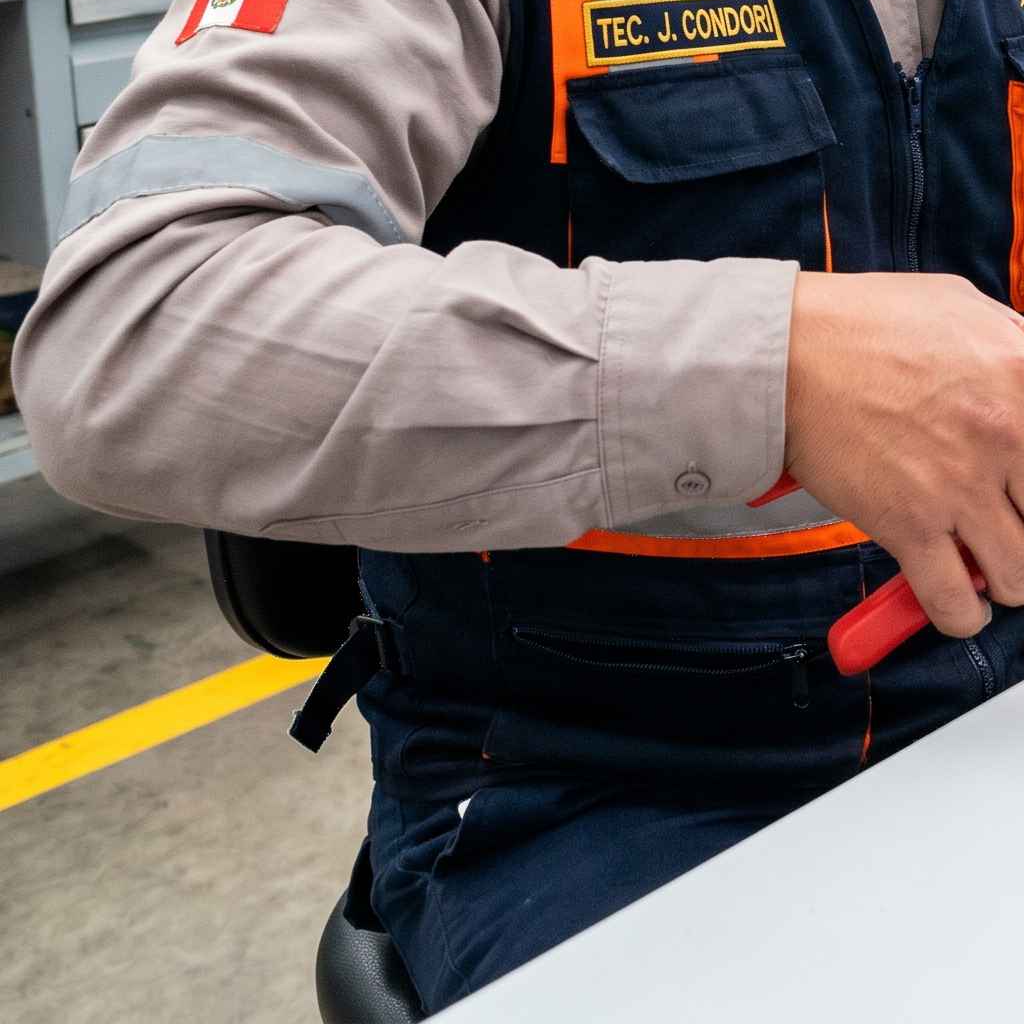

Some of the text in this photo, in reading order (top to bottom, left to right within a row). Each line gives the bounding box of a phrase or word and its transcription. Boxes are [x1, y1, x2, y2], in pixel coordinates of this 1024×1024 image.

[596, 4, 775, 50] TEC. J. CONDORI
